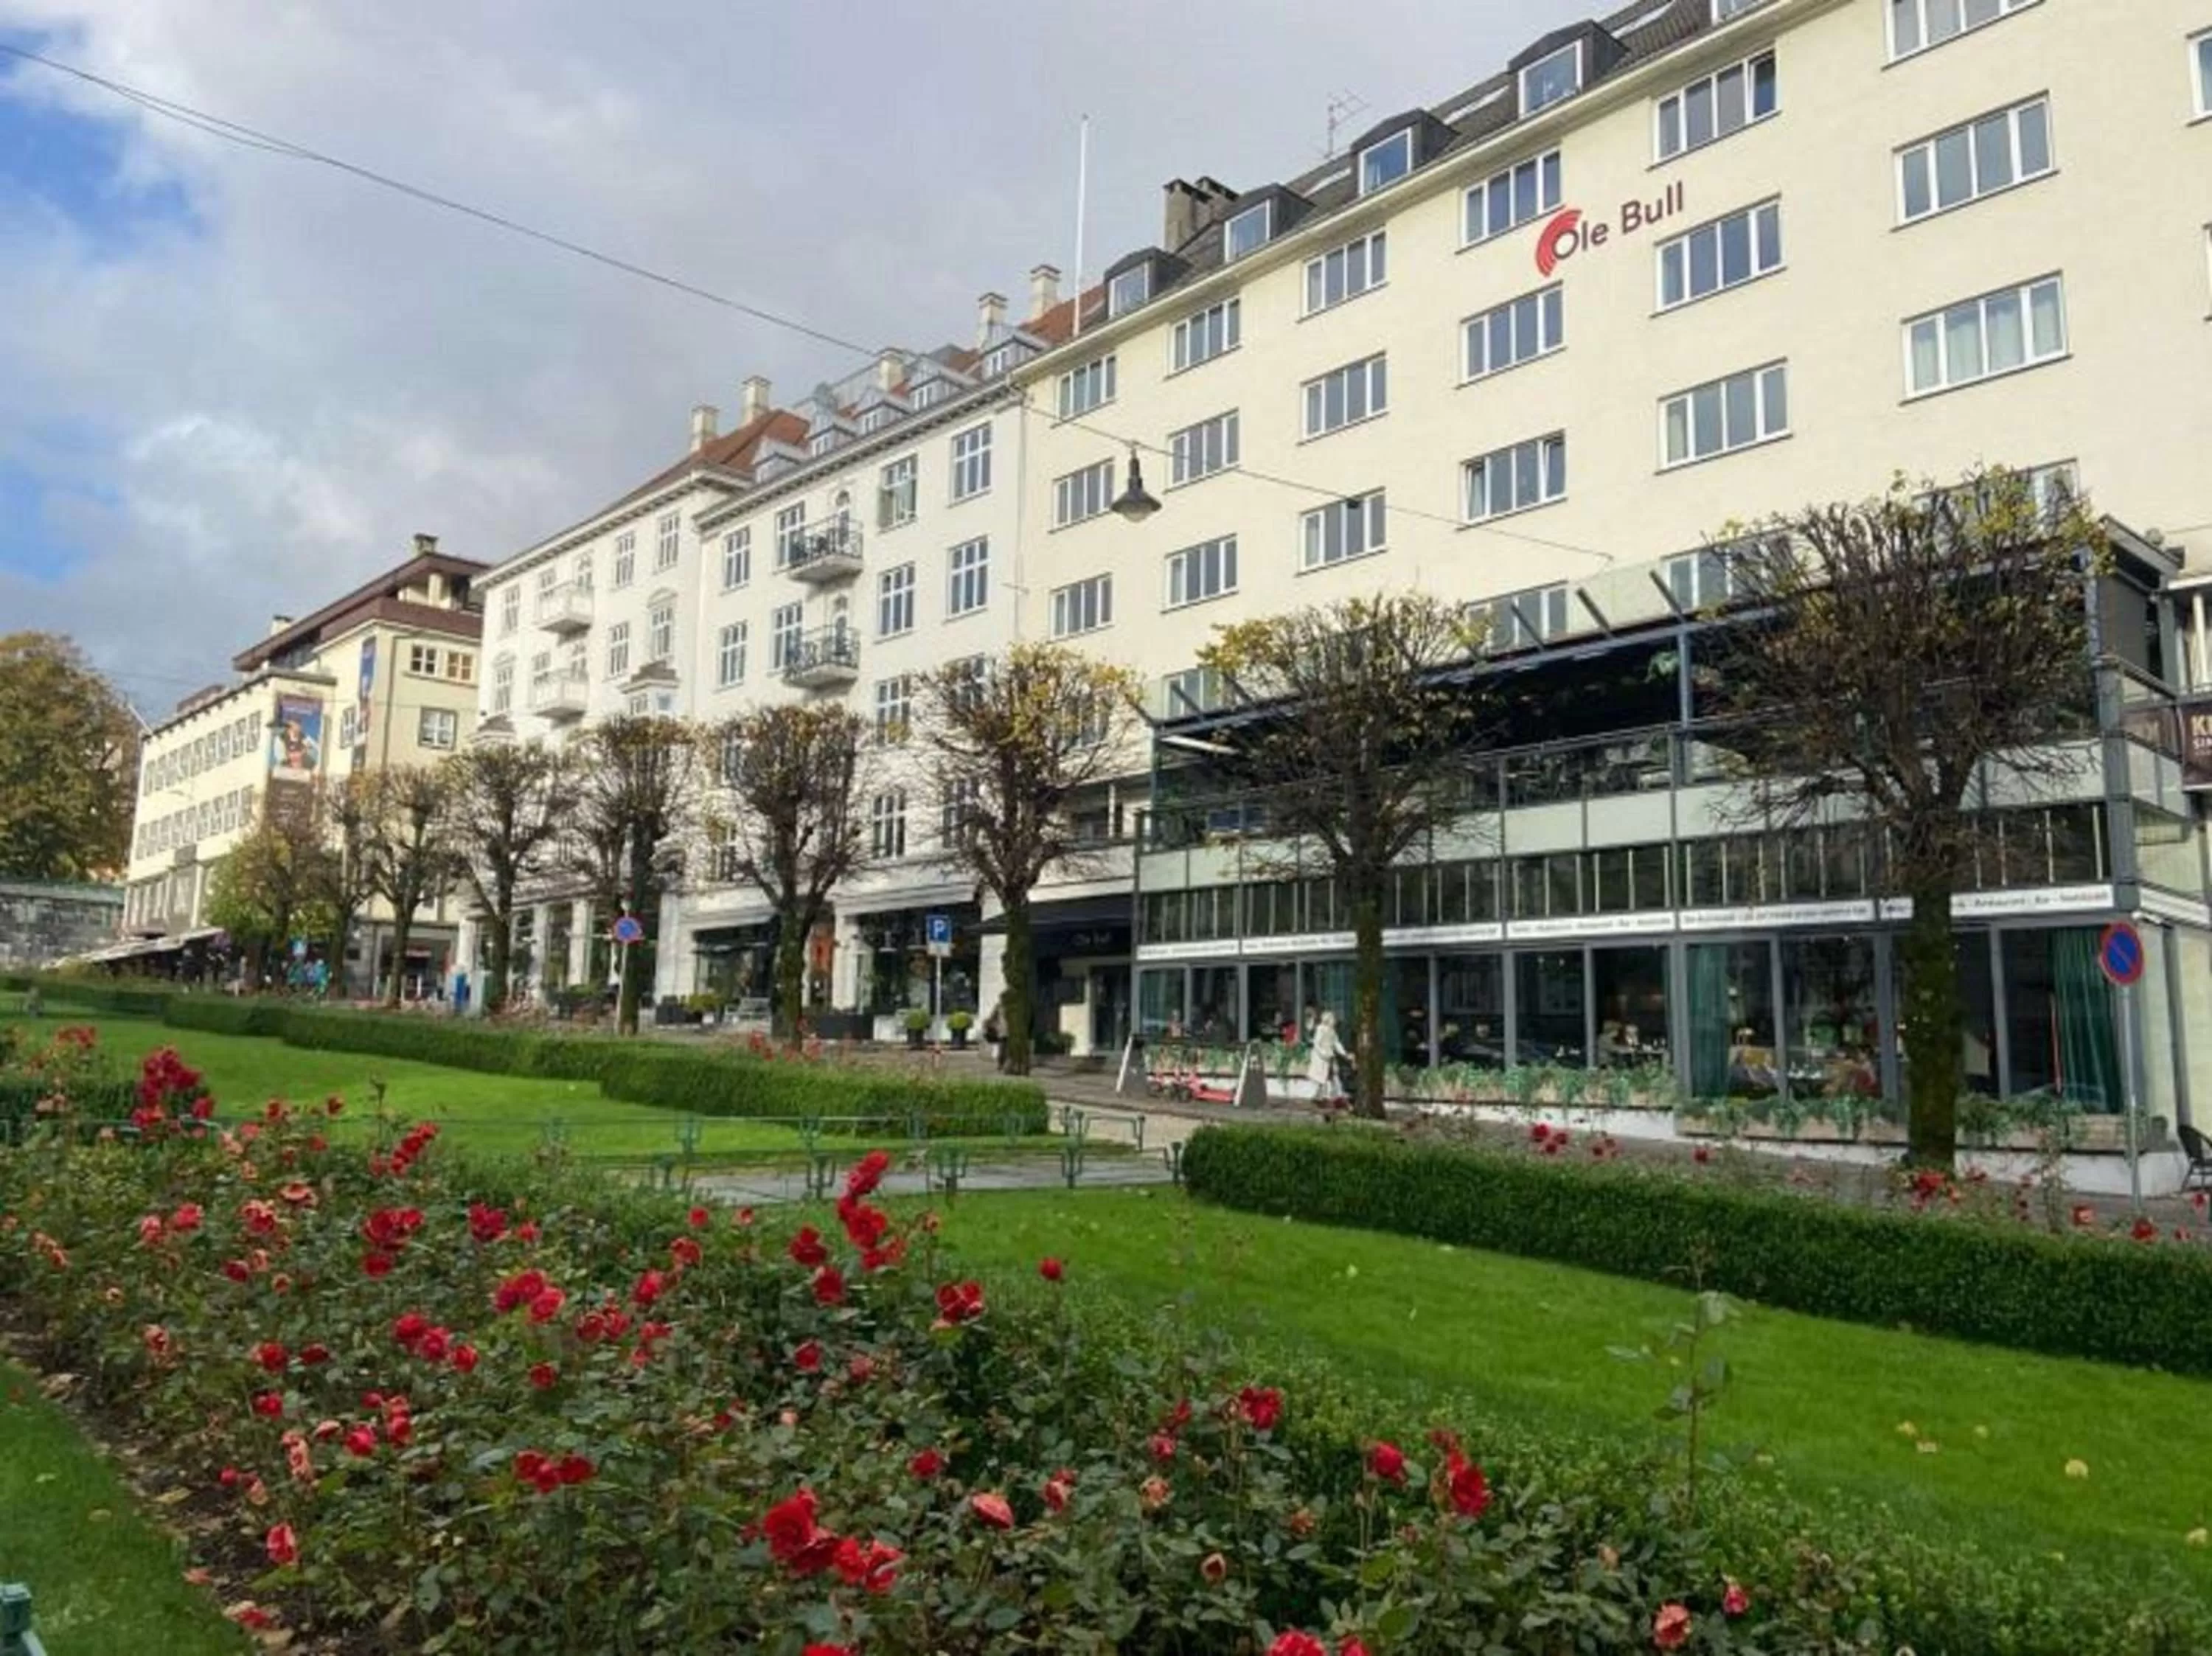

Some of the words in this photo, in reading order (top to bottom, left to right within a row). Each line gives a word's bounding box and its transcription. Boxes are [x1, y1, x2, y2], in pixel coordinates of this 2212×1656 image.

[1551, 220, 1610, 260] Ole
[1621, 180, 1683, 235] Bull
[933, 919, 946, 940] P
